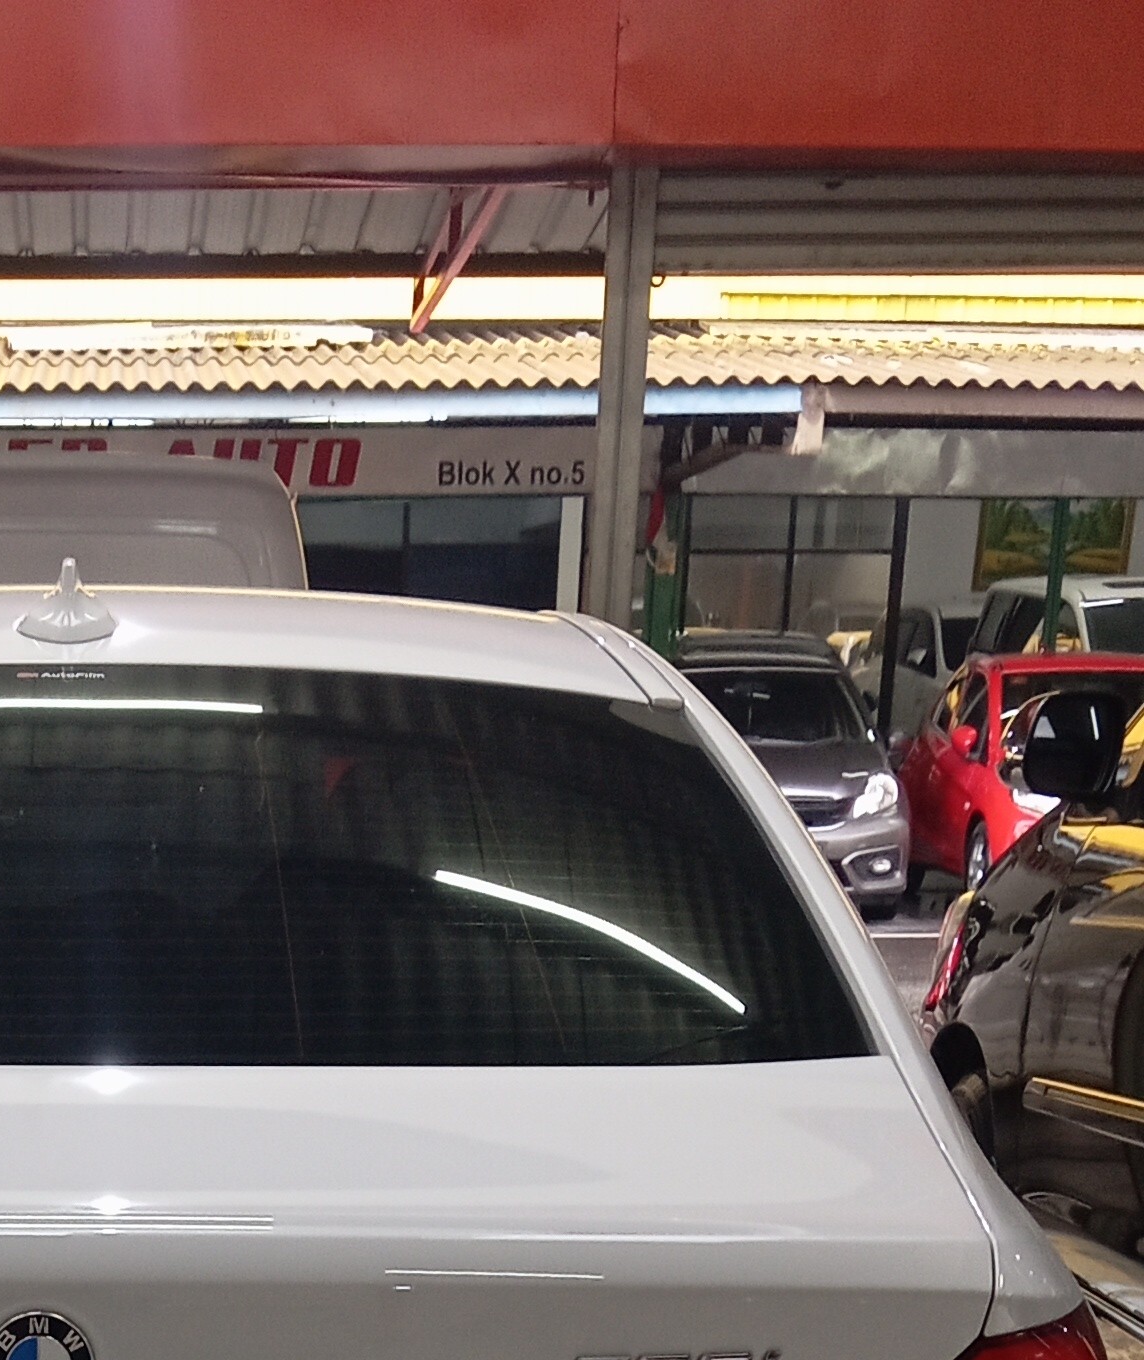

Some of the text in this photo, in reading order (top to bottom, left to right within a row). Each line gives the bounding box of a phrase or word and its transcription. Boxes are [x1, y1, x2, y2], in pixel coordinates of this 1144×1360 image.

[438, 460, 586, 486] Blok X no.5
